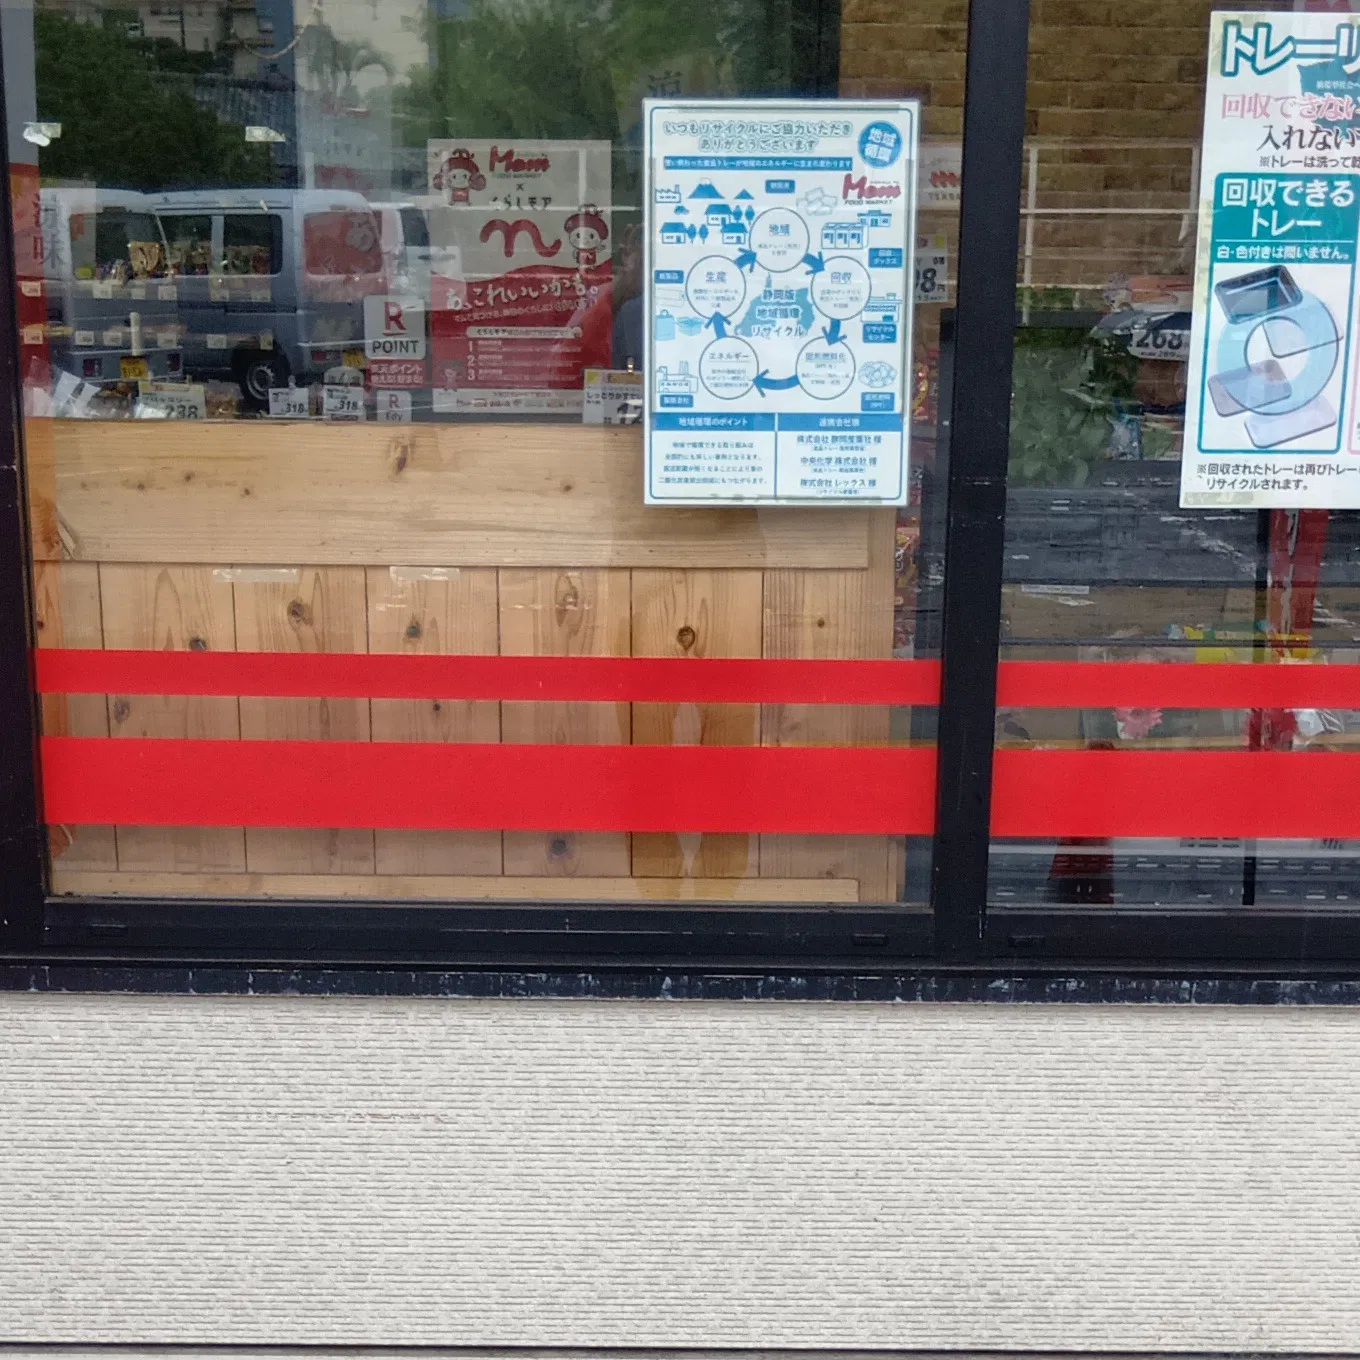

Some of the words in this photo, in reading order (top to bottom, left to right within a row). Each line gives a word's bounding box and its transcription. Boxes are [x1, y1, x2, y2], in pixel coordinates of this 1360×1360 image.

[664, 121, 853, 137] いつもリサイクルにご協力いただき
[698, 139, 820, 152] ありがとうございます
[1222, 177, 1355, 207] 回収できる
[1251, 210, 1321, 238] トレー
[1216, 245, 1351, 261] 白・色付きは問いません。
[752, 326, 805, 337] リサイクル
[372, 340, 419, 354] POINT
[708, 353, 750, 361] エネルギー
[1207, 477, 1310, 491] リサイクルされます。
